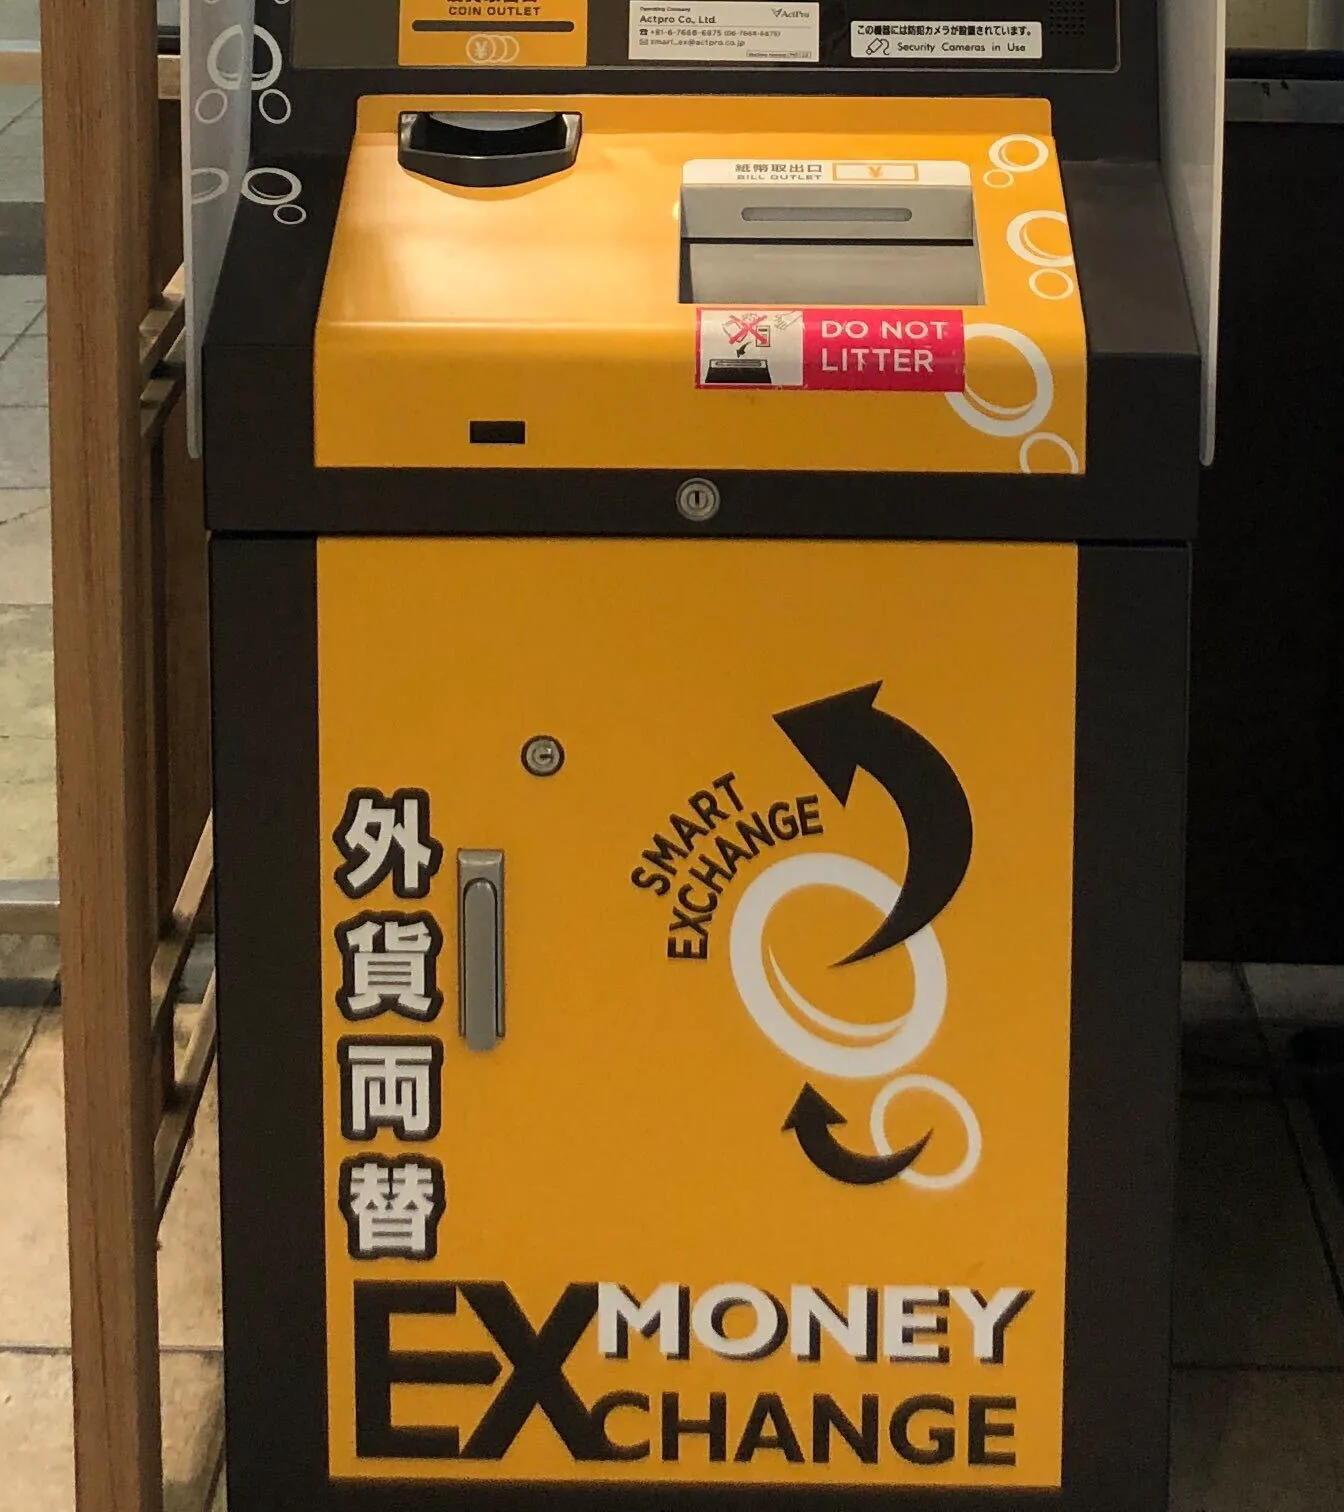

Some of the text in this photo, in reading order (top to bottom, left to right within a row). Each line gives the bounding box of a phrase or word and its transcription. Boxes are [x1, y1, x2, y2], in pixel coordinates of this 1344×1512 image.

[448, 6, 541, 16] COIN OUTLET
[640, 15, 674, 24] Actpro
[857, 25, 1032, 37] この機器には防犯カメラが設置されています。
[897, 41, 1026, 53] Security Cameras in Use
[735, 162, 824, 176] 紙幣取出口
[821, 320, 948, 339] DO NOT
[821, 348, 934, 373] LITTER
[630, 772, 746, 897] SMART
[667, 794, 824, 960] EXCHANGE
[342, 797, 438, 1253] 外貨両替
[597, 1282, 1034, 1361] MONEY
